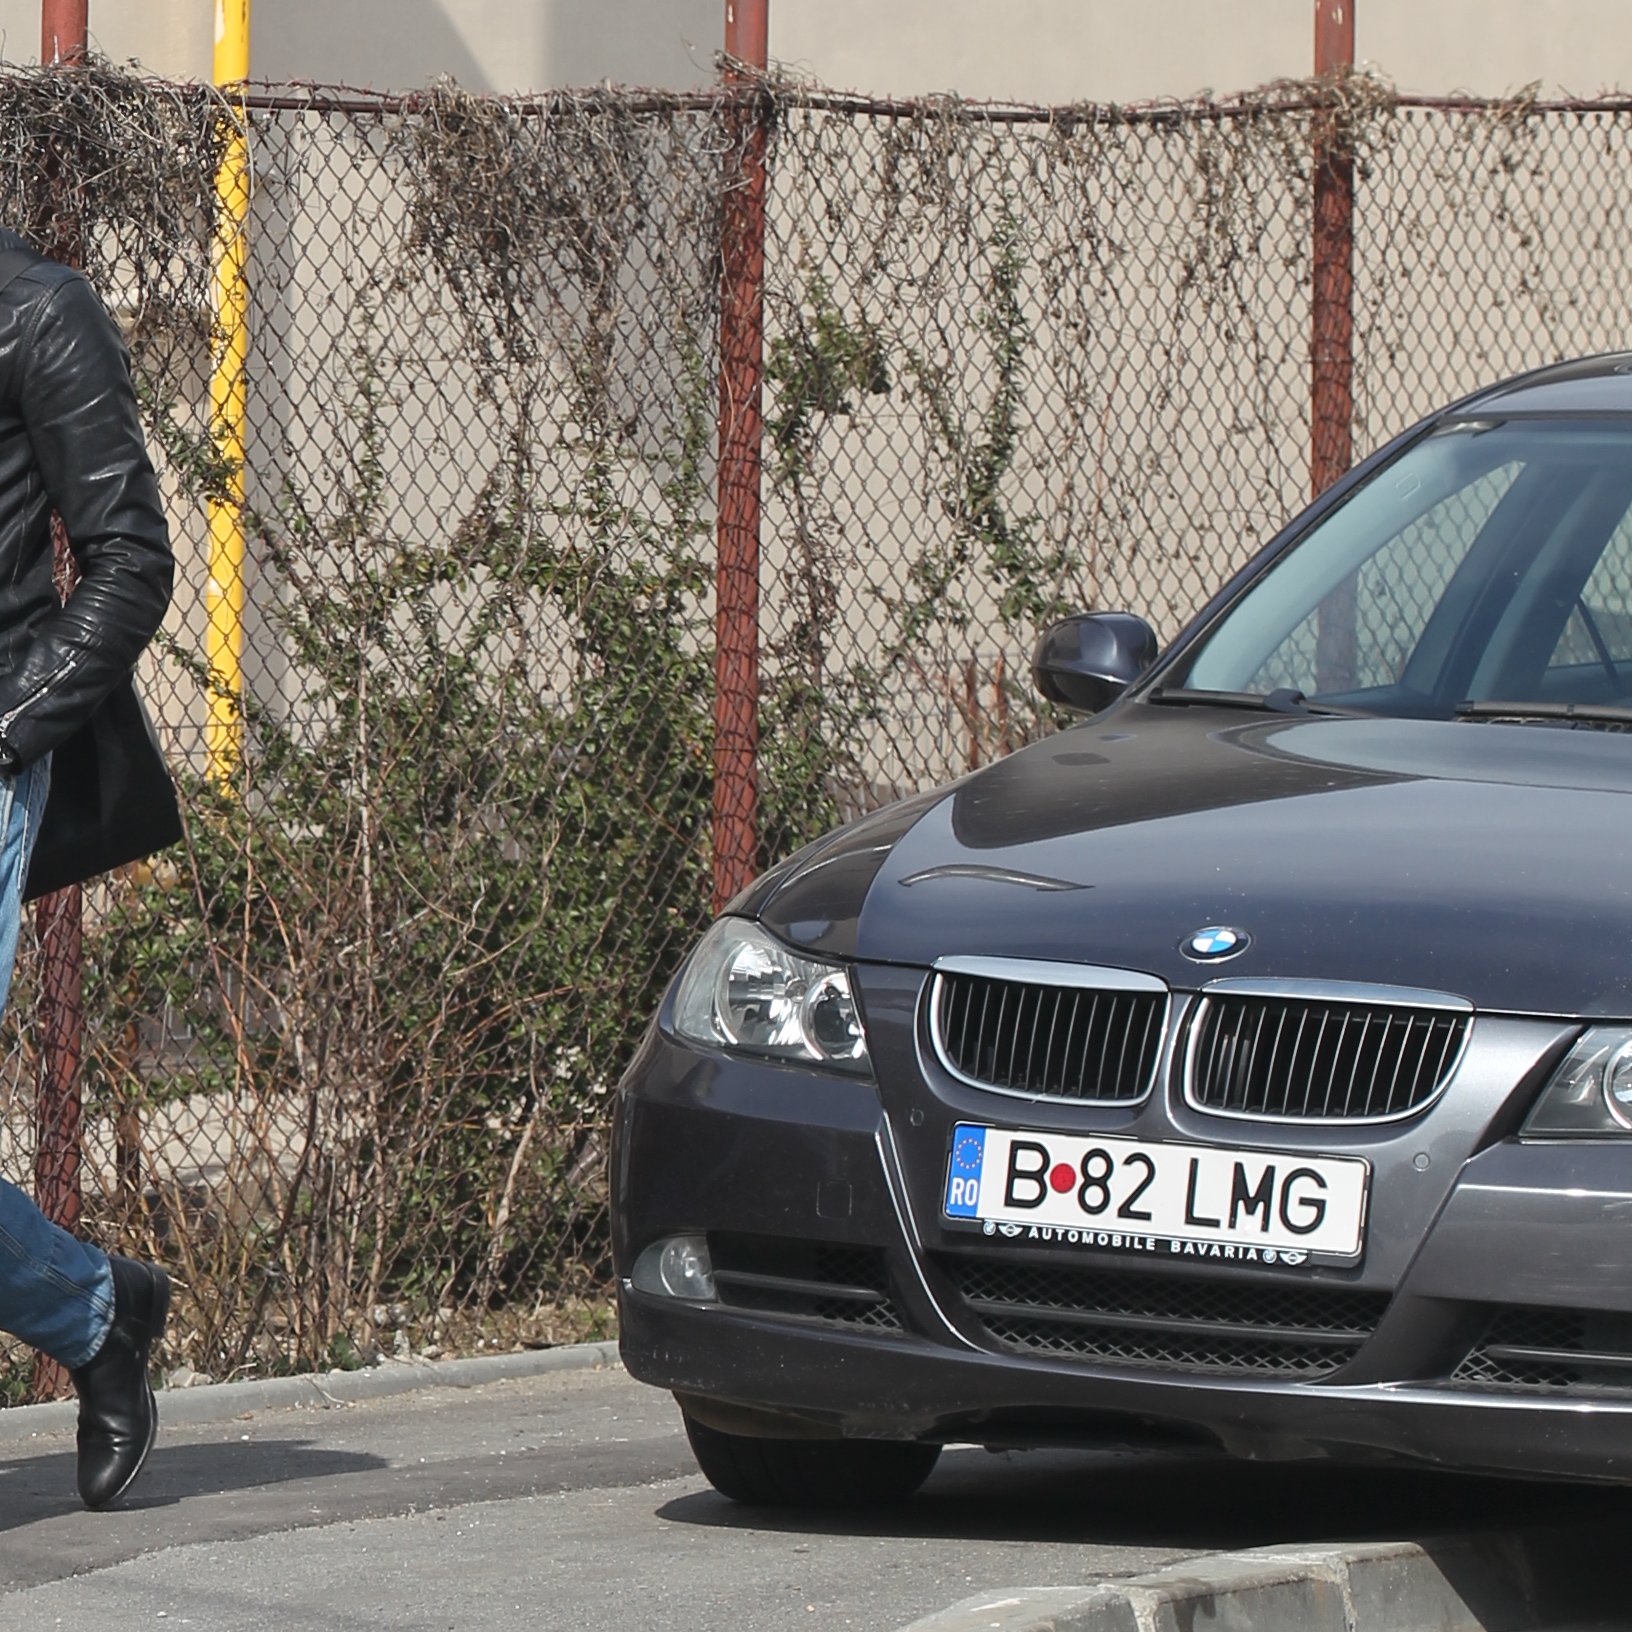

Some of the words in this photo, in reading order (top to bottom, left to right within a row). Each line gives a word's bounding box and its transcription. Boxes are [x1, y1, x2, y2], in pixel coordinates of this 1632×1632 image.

[949, 1176, 979, 1207] RO
[1003, 1138, 1051, 1209] B
[1077, 1147, 1156, 1221] 82
[1184, 1156, 1328, 1235] LMG
[1028, 1226, 1156, 1251] AUTOMOBILE
[1169, 1239, 1258, 1261] BAVARIA
